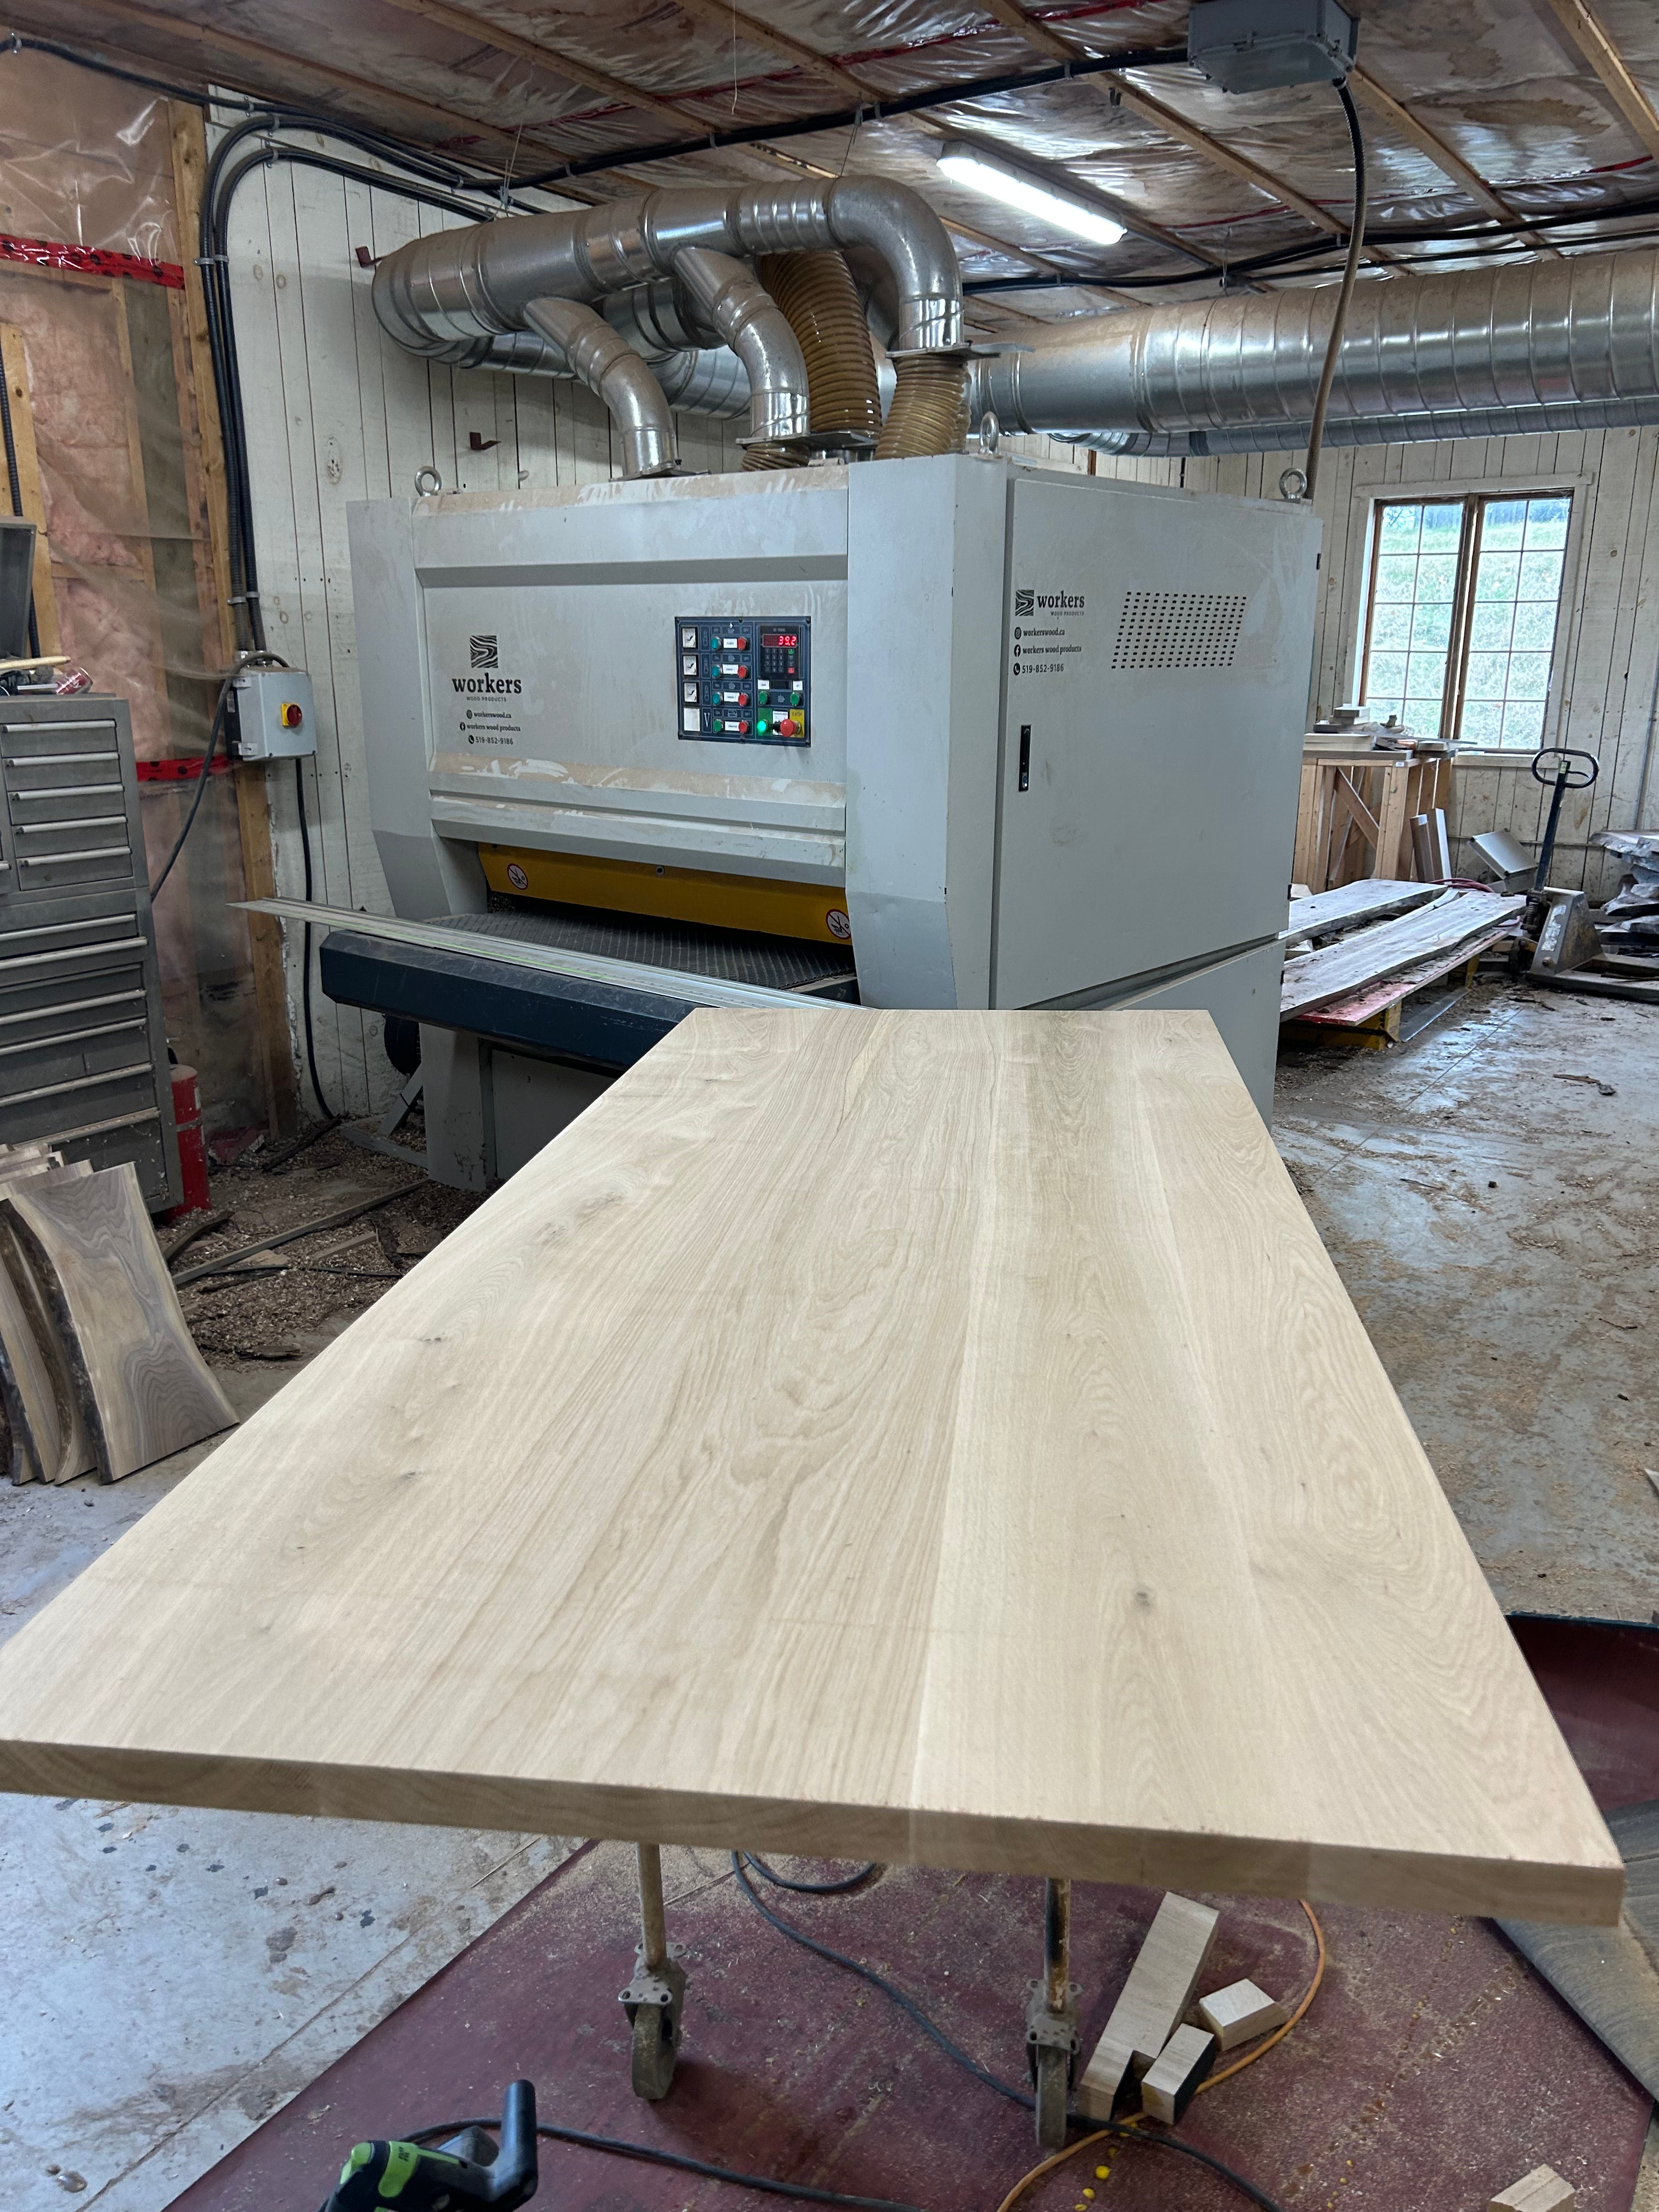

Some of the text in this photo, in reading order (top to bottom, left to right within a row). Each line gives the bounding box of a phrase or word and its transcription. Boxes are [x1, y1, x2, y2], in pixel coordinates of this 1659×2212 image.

[1037, 590, 1085, 608] workers
[1023, 627, 1065, 636] workerswood.ca
[1023, 644, 1082, 655] workers wood products
[1022, 663, 1064, 674] 519-852-9186
[452, 672, 522, 693] workers
[475, 736, 514, 745] 519-852-9186
